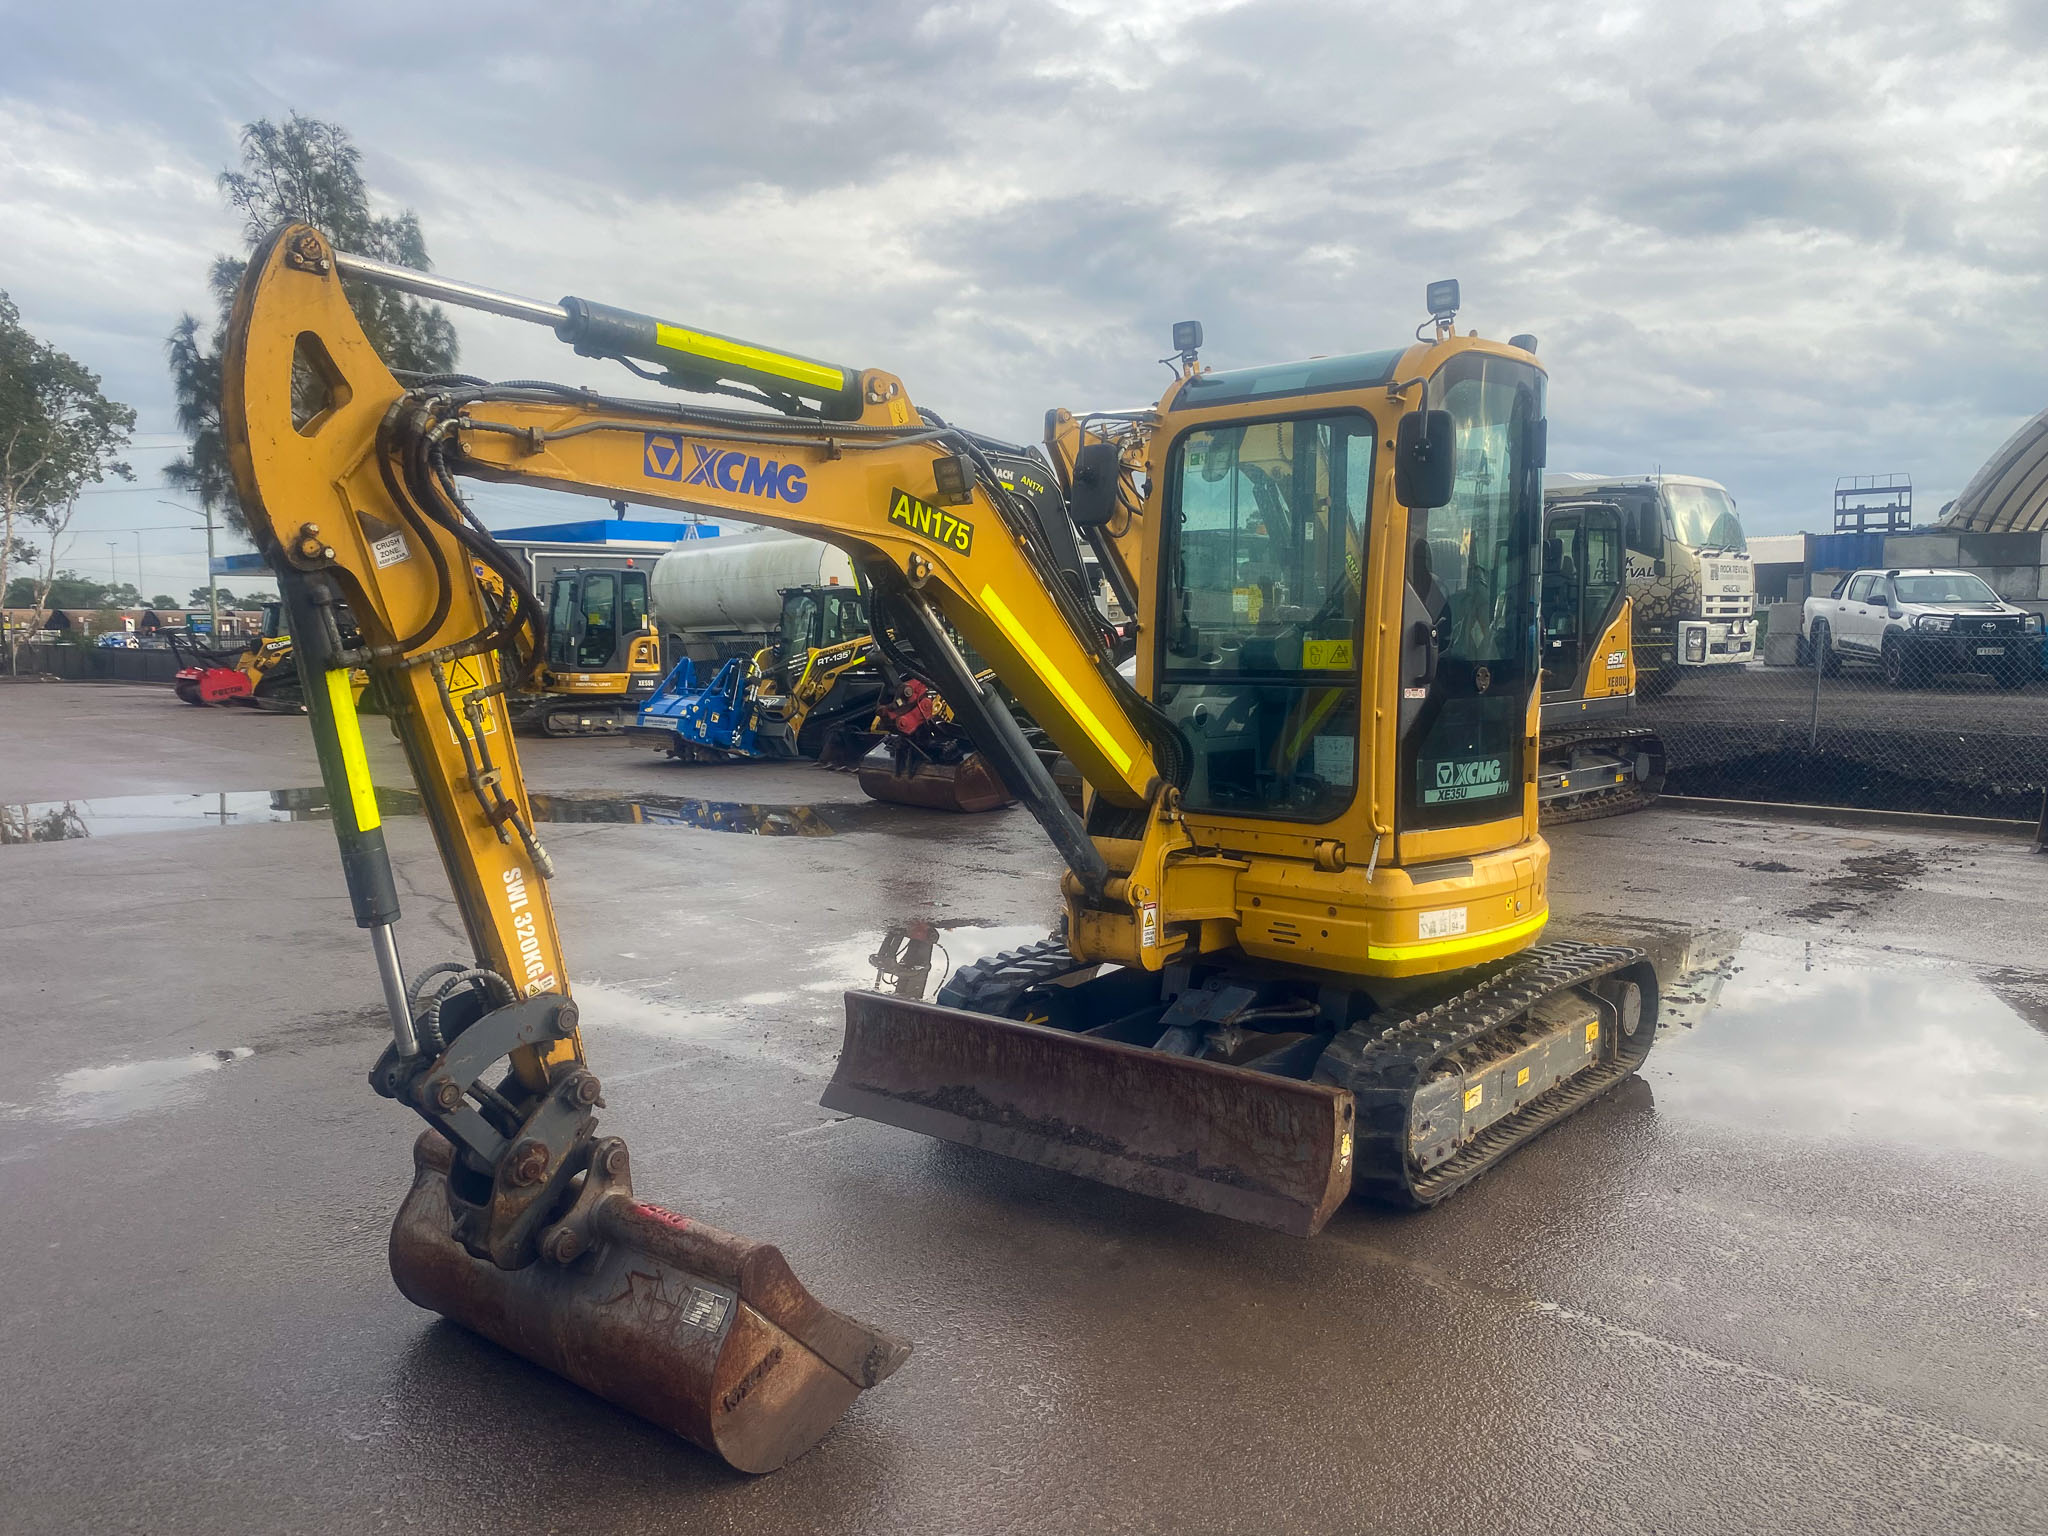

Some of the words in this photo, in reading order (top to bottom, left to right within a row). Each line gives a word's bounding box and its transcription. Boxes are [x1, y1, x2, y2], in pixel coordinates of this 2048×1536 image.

[683, 444, 808, 503] XCMG
[1020, 475, 1044, 494] AN174
[892, 495, 970, 550] AN175
[376, 538, 400, 550] CRUSH
[380, 547, 400, 558] ZONE
[818, 650, 850, 665] RT-135
[1607, 676, 1626, 688] XE80U
[1454, 760, 1500, 786] XCMG
[1438, 788, 1467, 800] XE35U
[502, 867, 528, 914] SWL
[514, 912, 545, 980] 320KG
